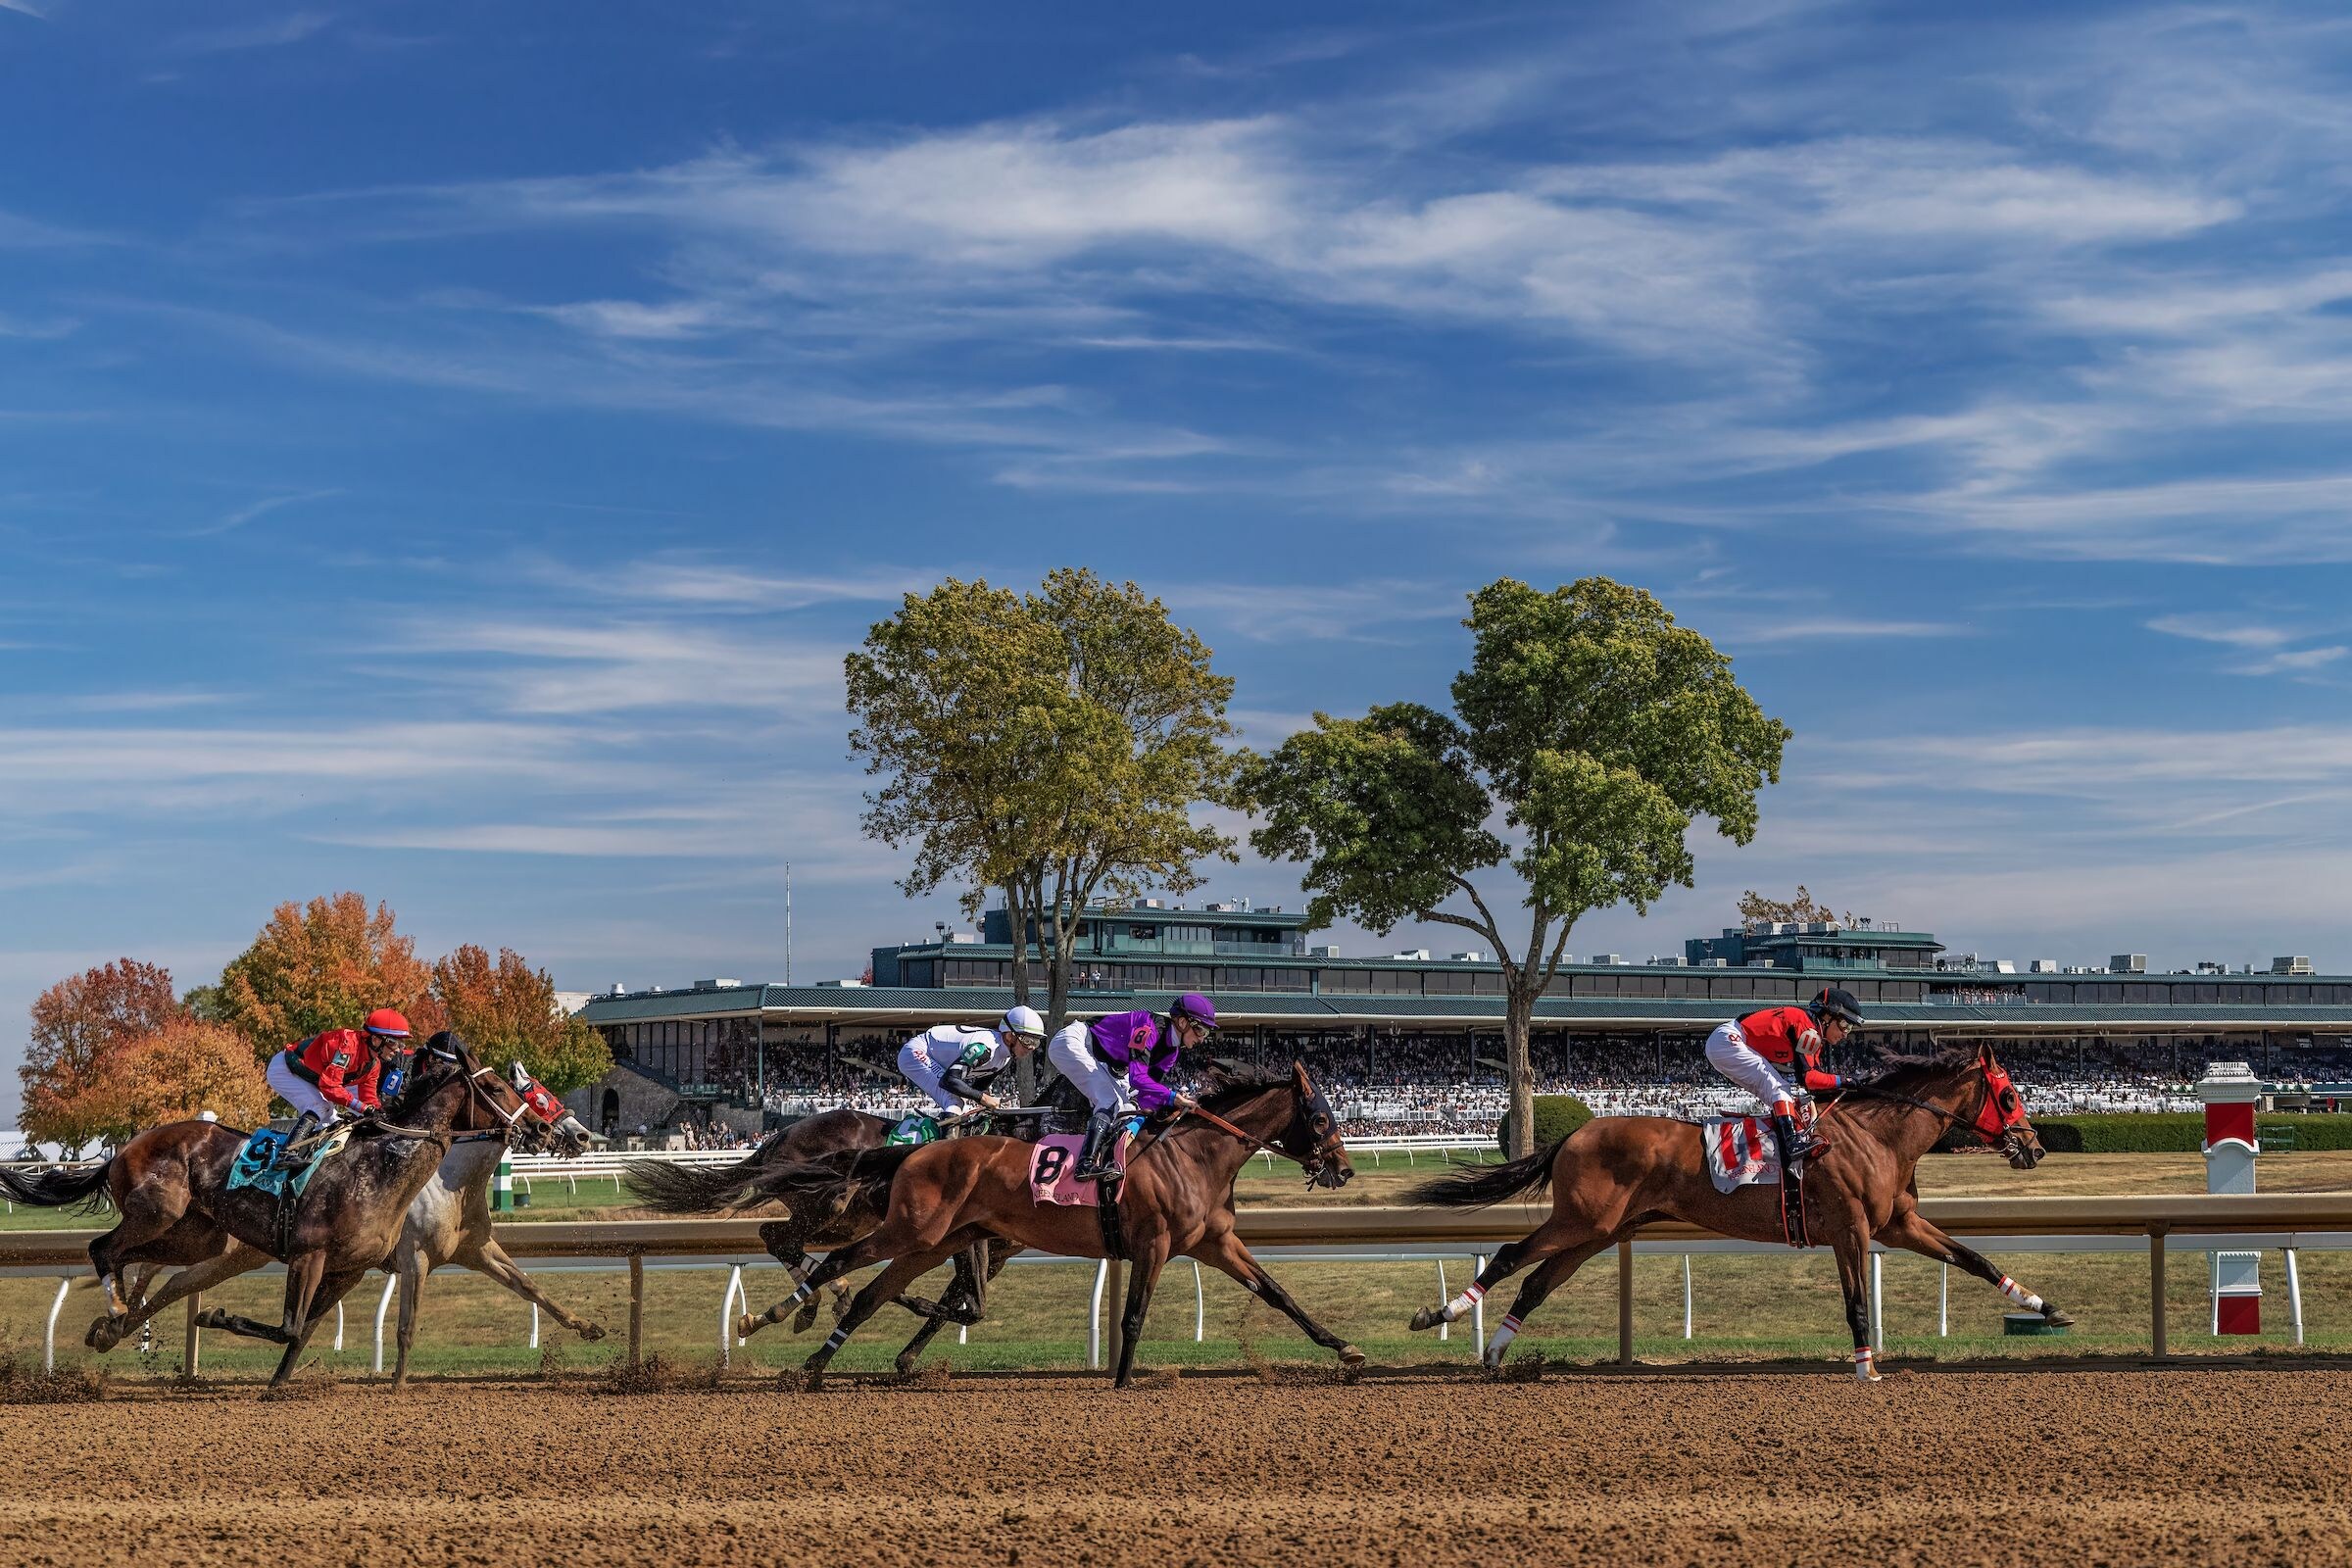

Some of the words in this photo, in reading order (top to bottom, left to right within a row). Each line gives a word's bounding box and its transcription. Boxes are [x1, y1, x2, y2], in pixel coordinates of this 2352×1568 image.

[1135, 1030, 1147, 1044] 8
[965, 1045, 981, 1060] 5
[387, 1074, 399, 1090] 3
[1033, 1146, 1069, 1185] 8
